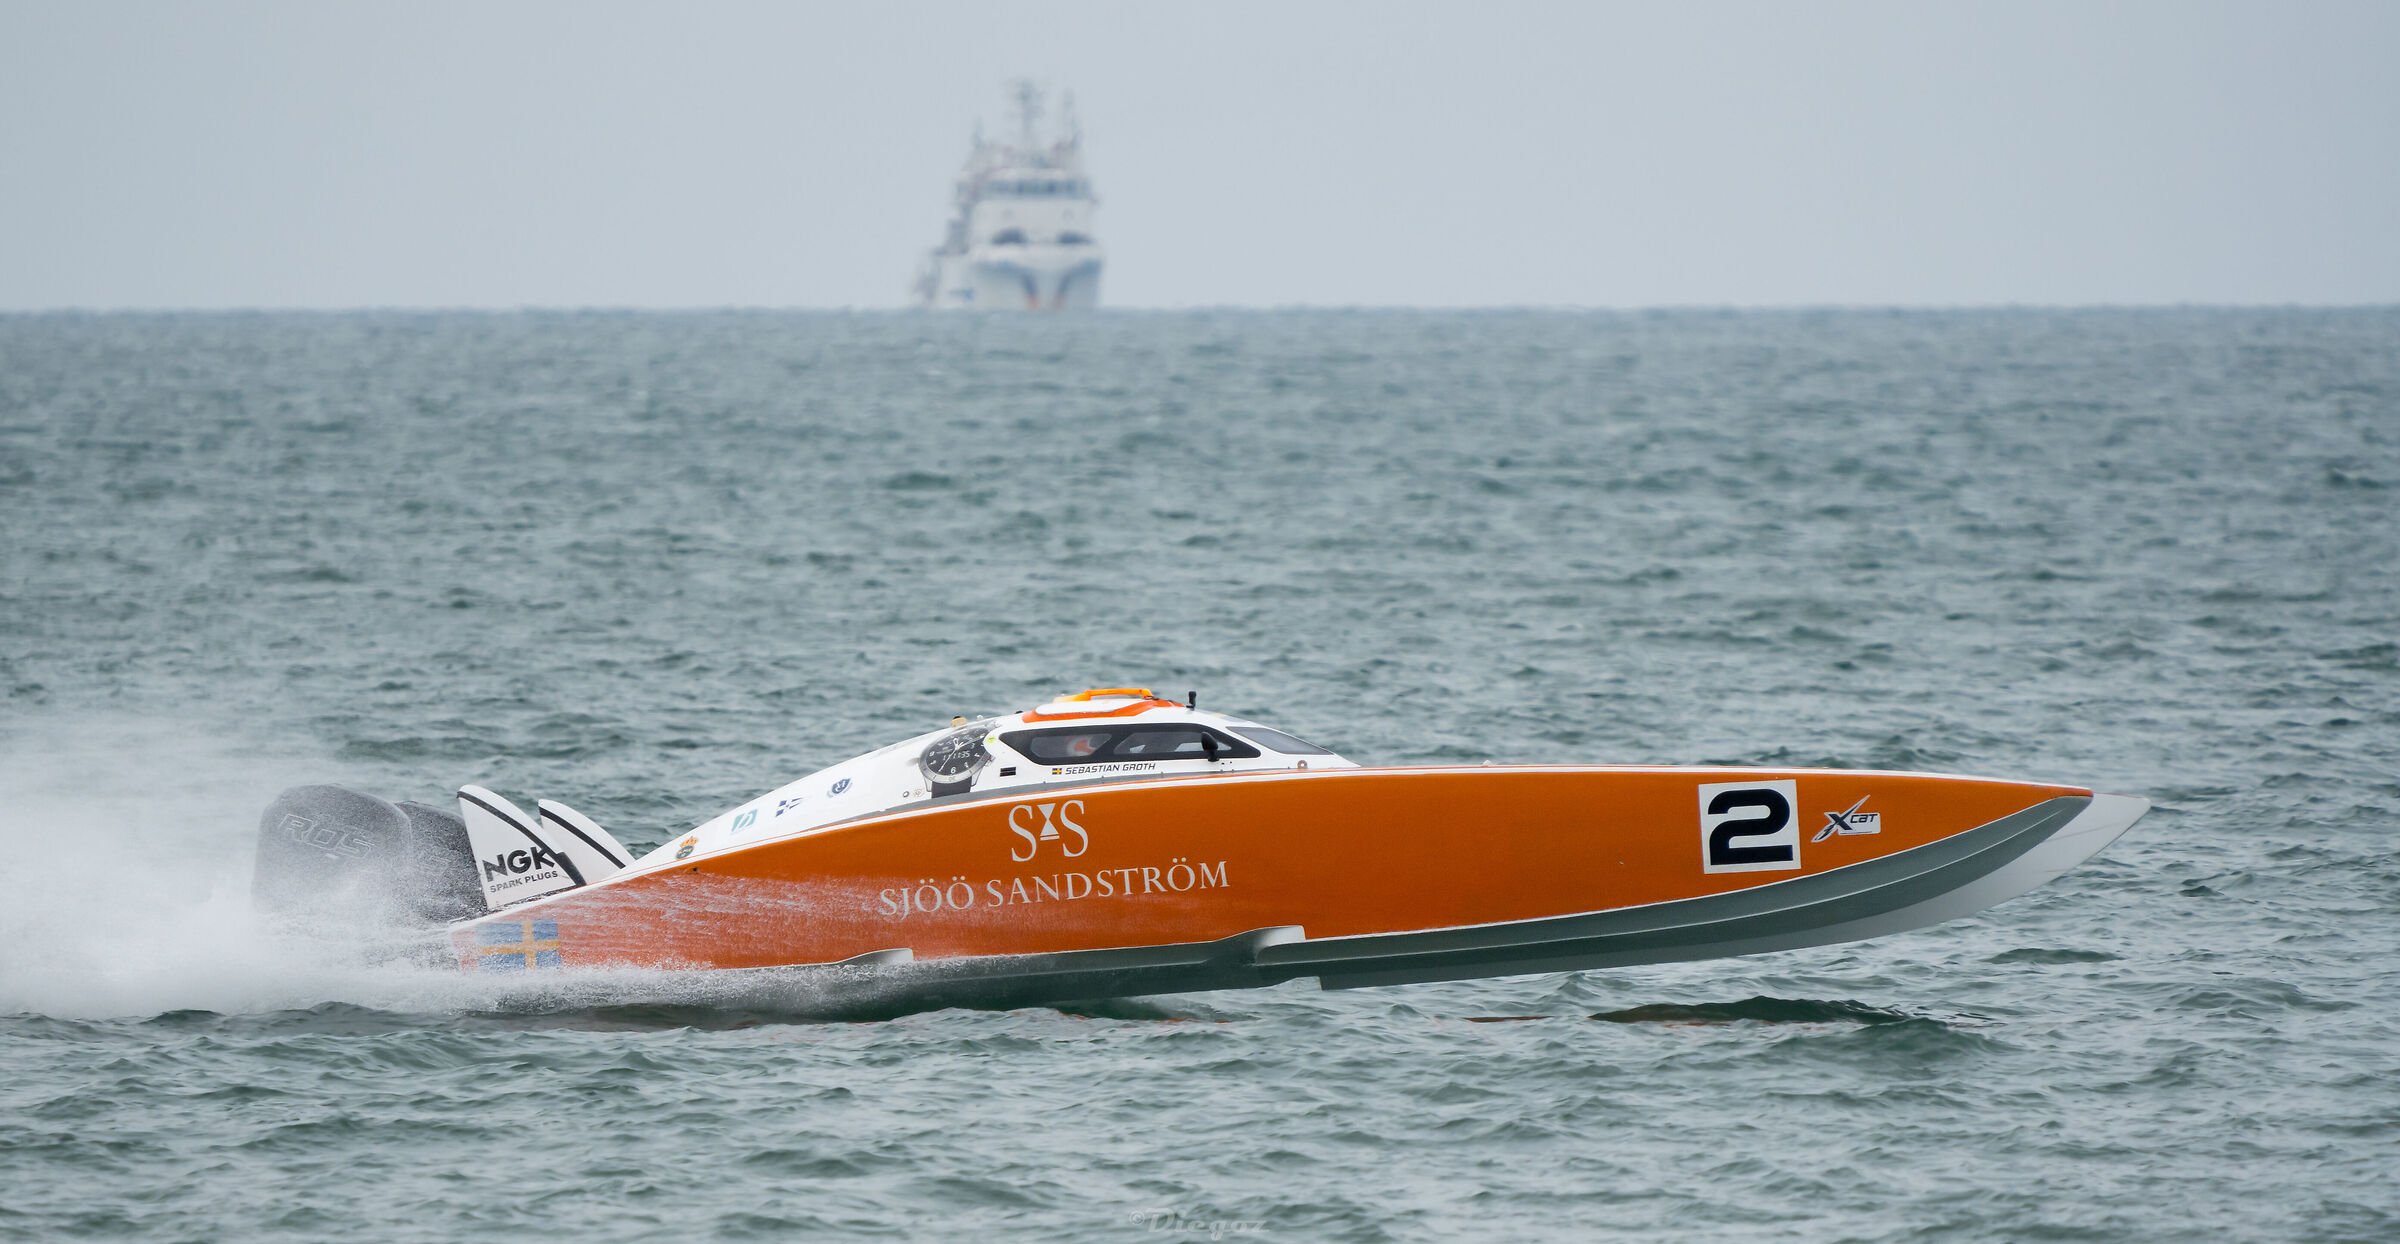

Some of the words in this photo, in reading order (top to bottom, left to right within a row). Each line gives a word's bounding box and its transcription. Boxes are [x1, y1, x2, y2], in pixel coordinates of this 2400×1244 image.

[1065, 764, 1120, 775] SEBASTIAN
[1122, 763, 1156, 771] GROTH
[1707, 788, 1794, 866] 2
[482, 846, 555, 882] NGK
[490, 878, 523, 893] SPARK
[524, 870, 558, 883] PLUGS
[879, 875, 975, 920] SJÖÖ
[986, 857, 1231, 908] SANDSTRÖM
